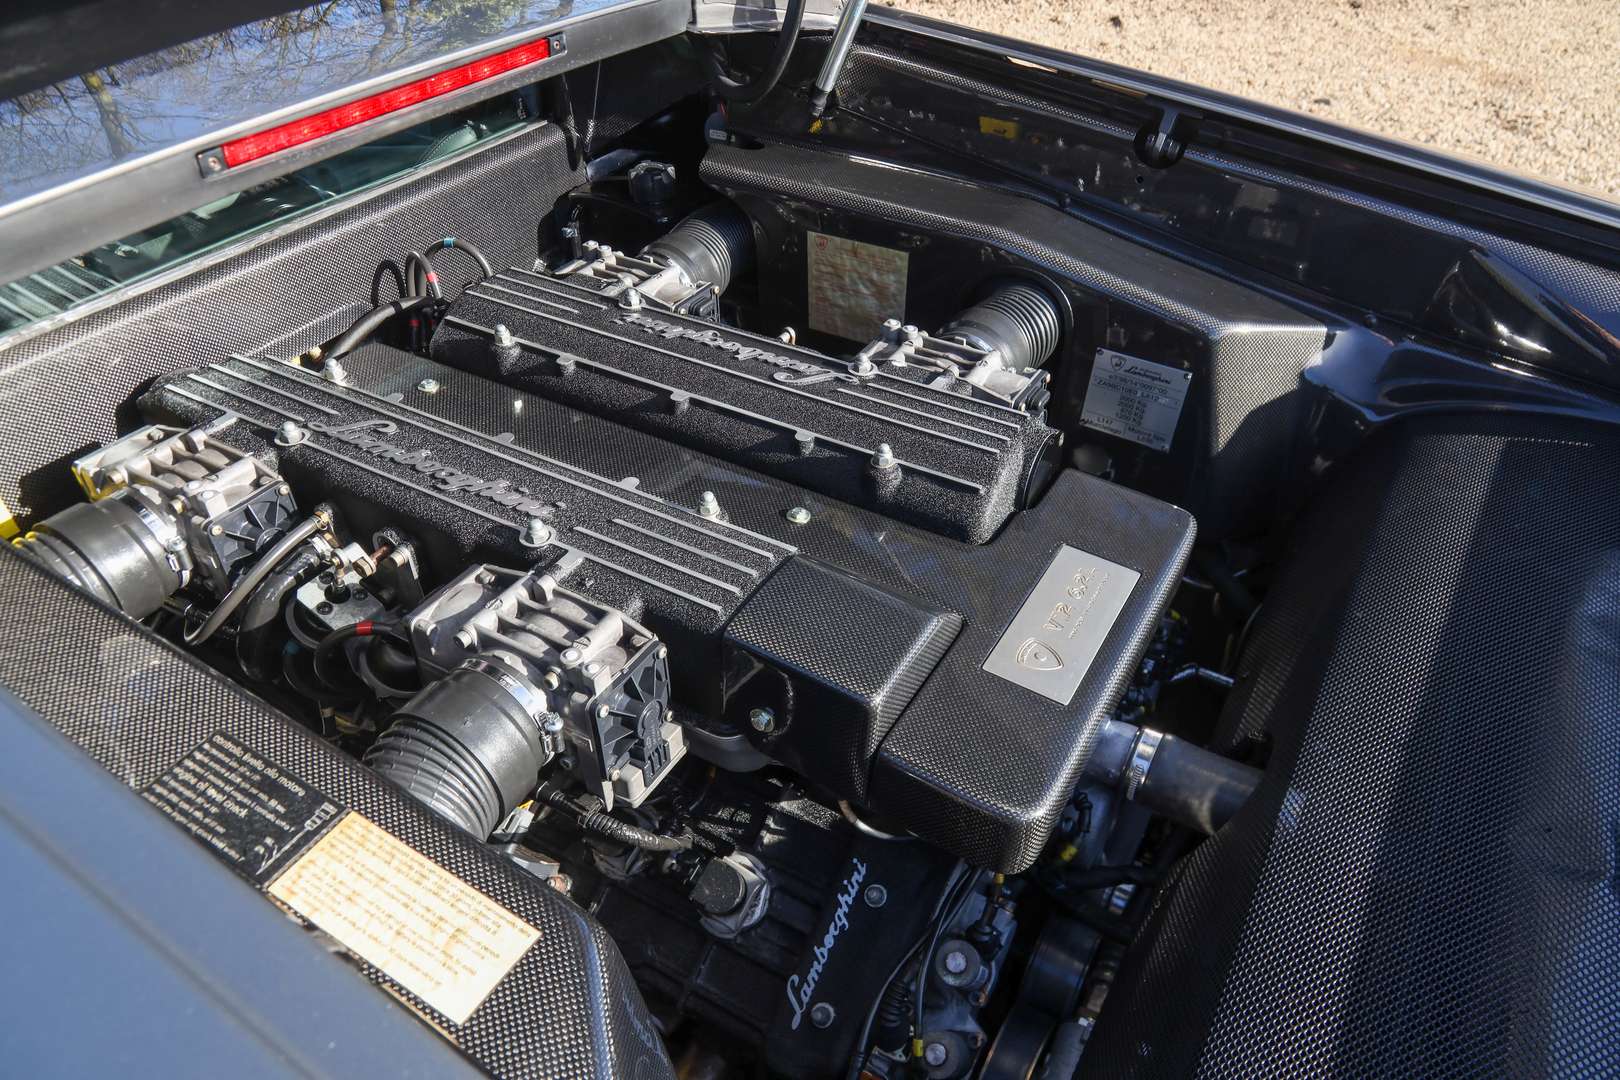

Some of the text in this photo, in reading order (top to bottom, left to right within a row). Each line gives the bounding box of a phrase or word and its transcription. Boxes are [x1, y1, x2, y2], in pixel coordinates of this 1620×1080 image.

[308, 420, 567, 516] Lamborghini
[212, 734, 244, 758] controllo
[242, 752, 265, 771] livello
[277, 775, 306, 797] motore
[787, 858, 866, 1030] Lamborghini
